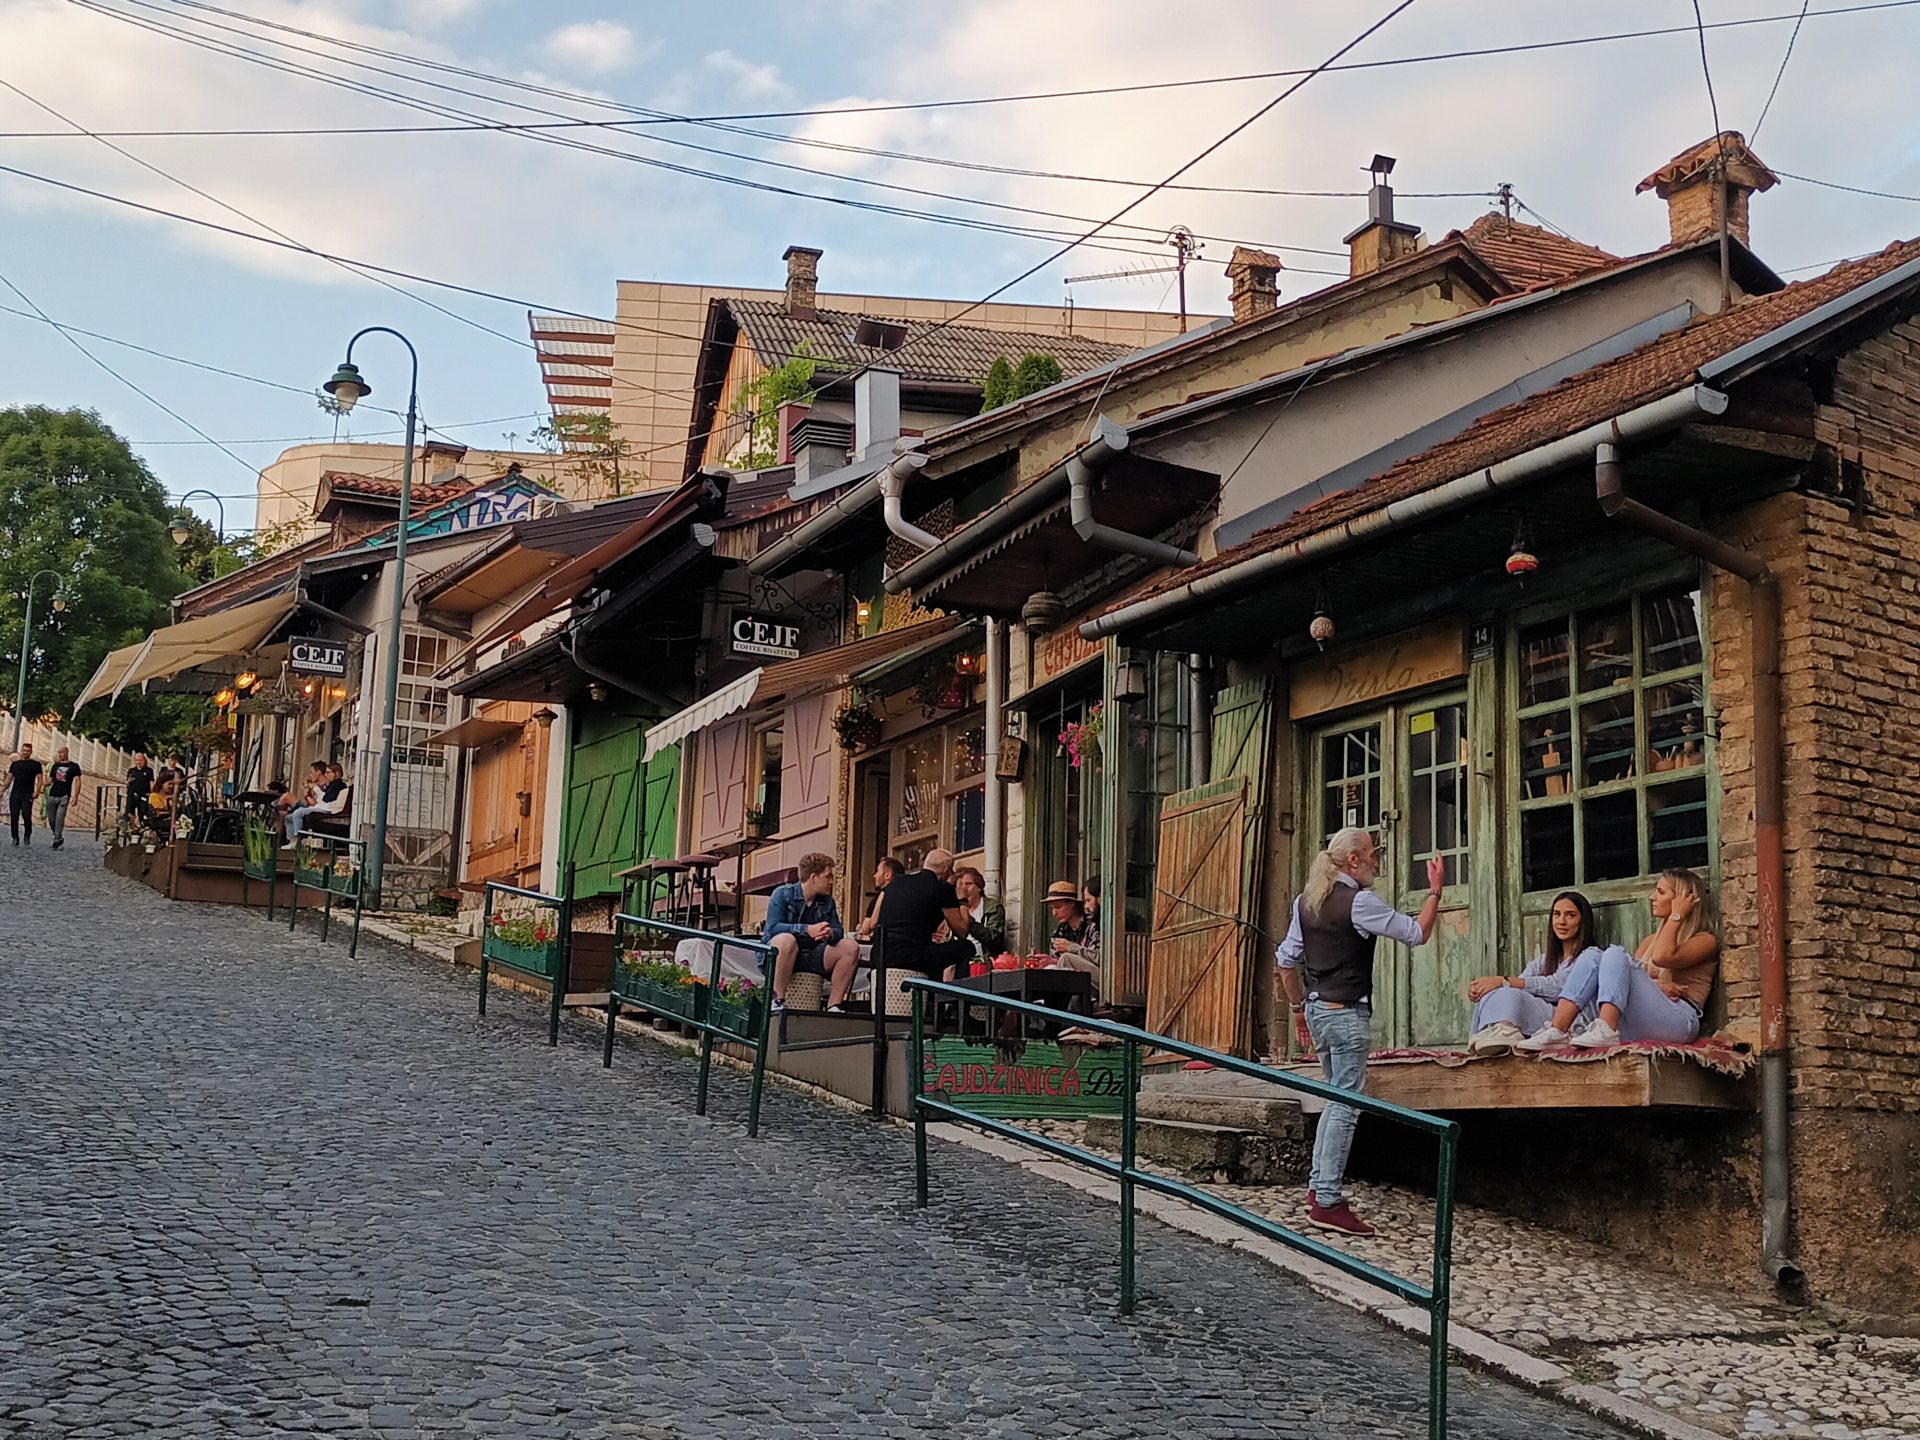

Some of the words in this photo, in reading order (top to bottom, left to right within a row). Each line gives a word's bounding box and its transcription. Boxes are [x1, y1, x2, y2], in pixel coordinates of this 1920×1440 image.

[1474, 627, 1487, 644] 14
[735, 643, 762, 653] COFFEE
[763, 647, 797, 657] ROASTERS
